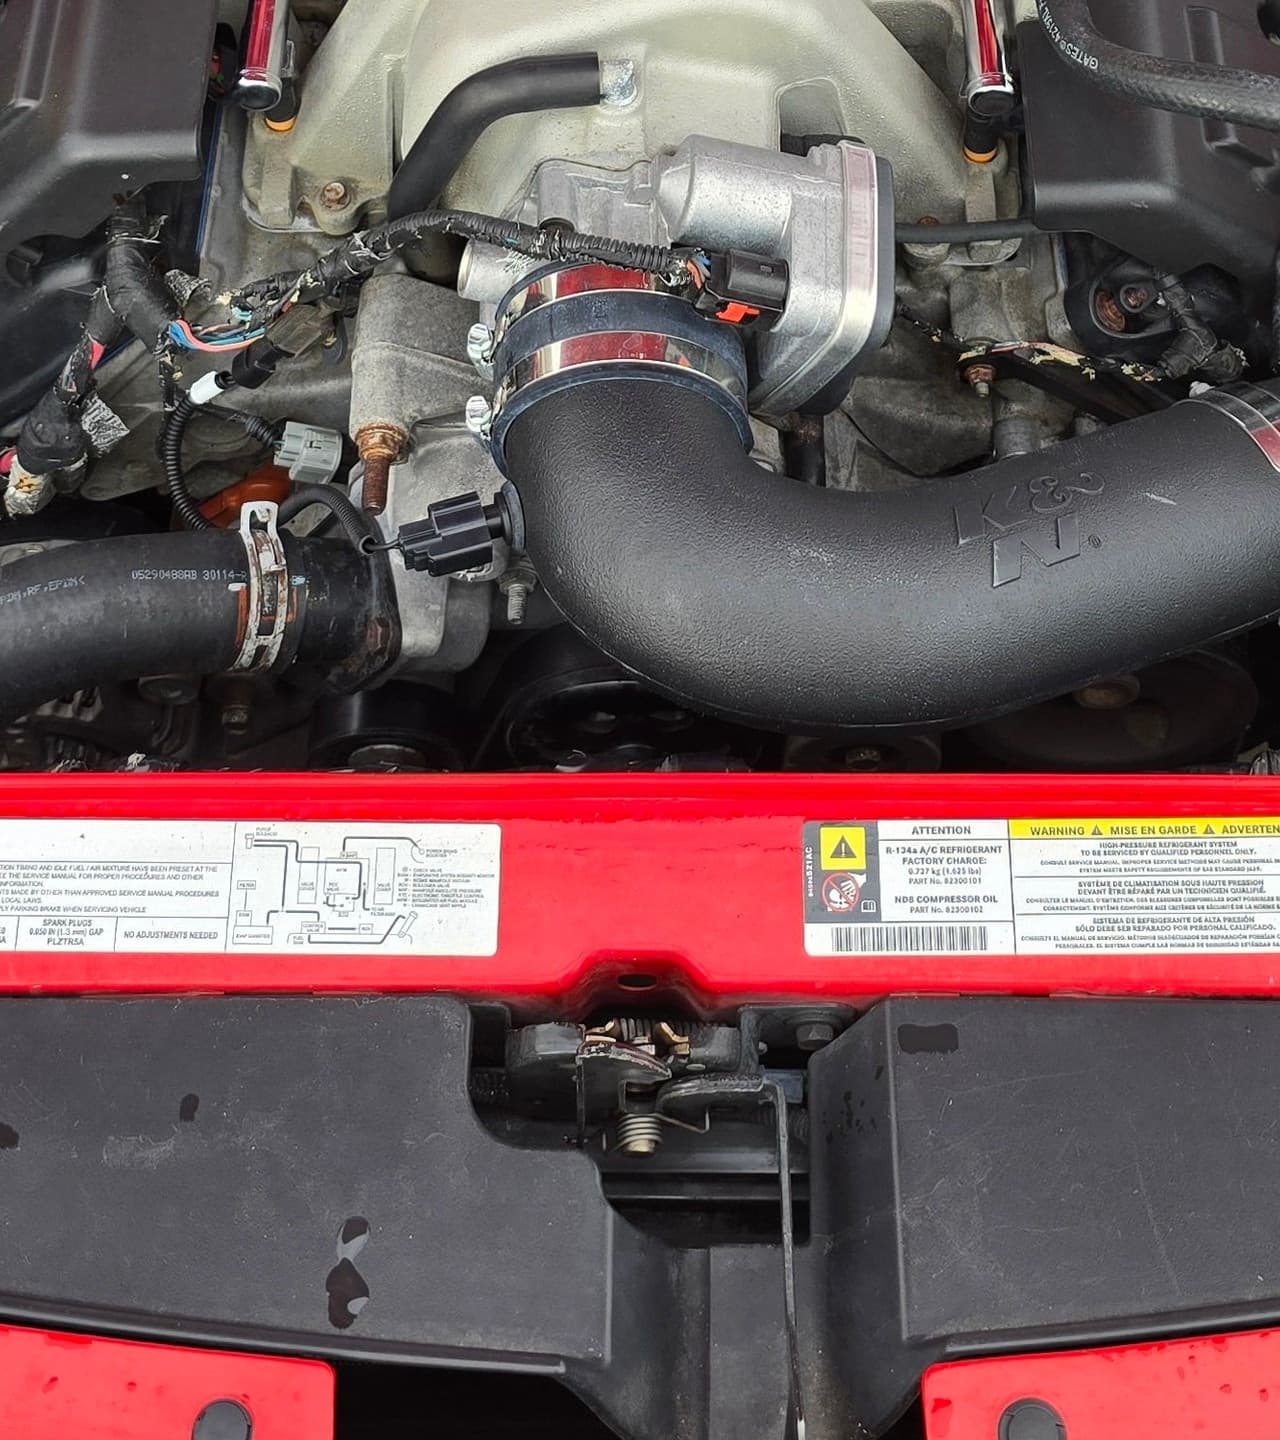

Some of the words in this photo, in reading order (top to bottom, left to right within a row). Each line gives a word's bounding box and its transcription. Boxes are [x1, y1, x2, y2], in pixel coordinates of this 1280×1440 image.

[911, 826, 972, 835] ATTENTION
[1031, 826, 1085, 836] WARNING
[1110, 826, 1137, 835] MISE
[1140, 826, 1155, 835] EN
[1158, 825, 1197, 835] GARDE
[902, 857, 943, 865] FACTORY
[946, 857, 987, 865] CHARGE:
[124, 931, 134, 940] NO
[135, 931, 187, 940] ADJUSTMENTS
[188, 931, 218, 940] NEEDED
